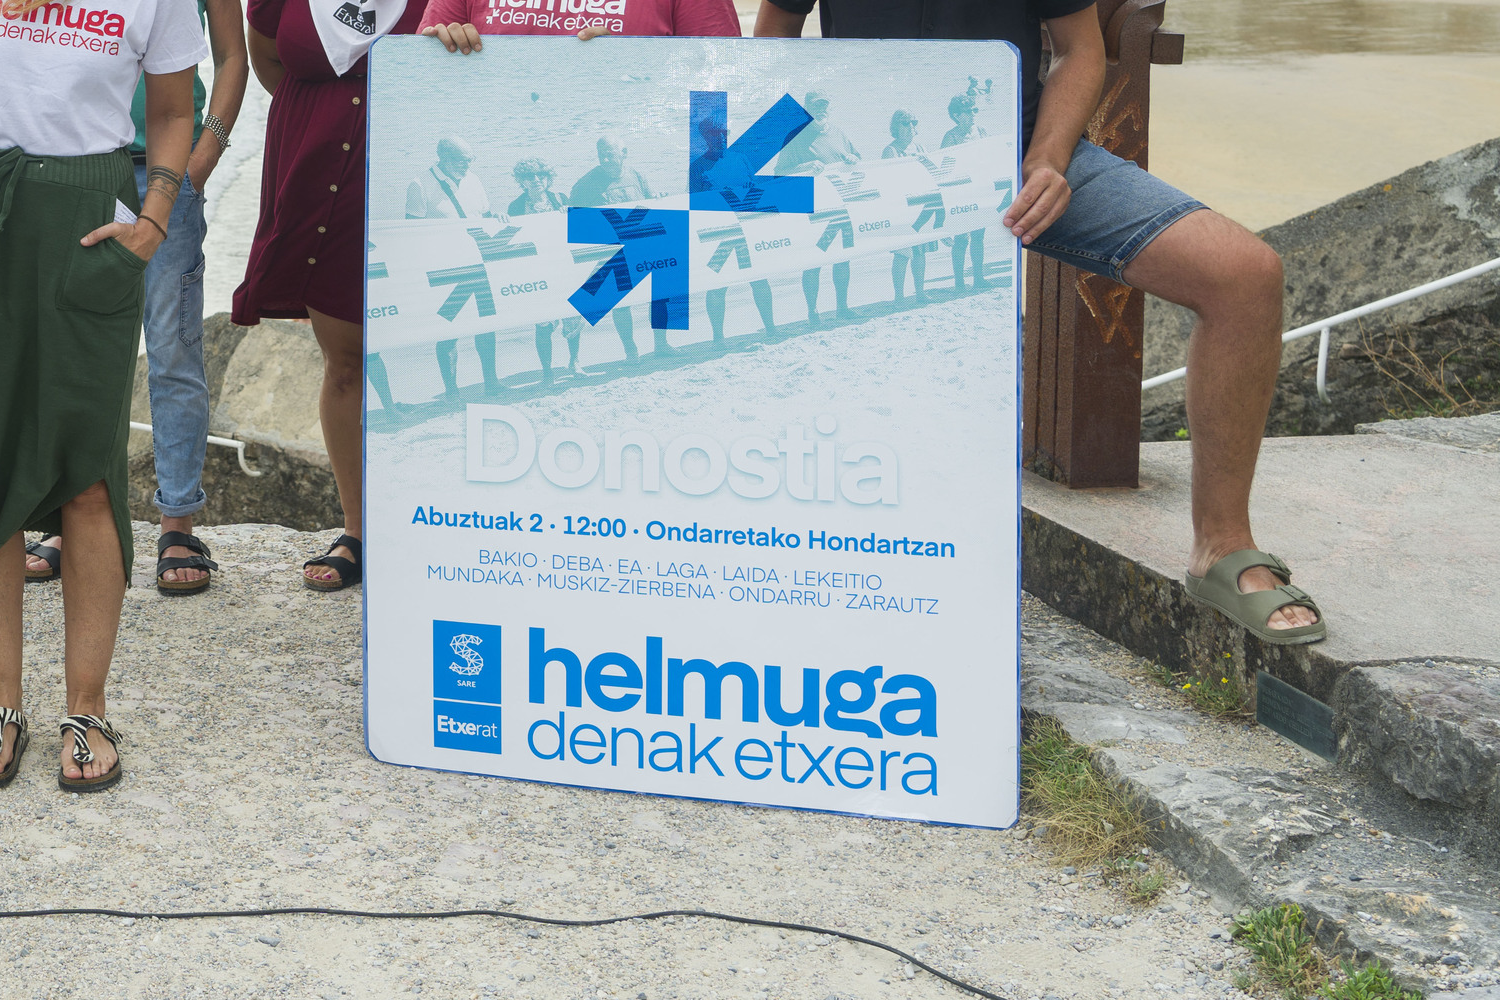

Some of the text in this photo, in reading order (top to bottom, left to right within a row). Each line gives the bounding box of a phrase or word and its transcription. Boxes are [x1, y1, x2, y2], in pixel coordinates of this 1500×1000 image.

[499, 8, 624, 32] denak etxera
[58, 31, 120, 56] etxera
[950, 202, 979, 215] etxera
[858, 217, 892, 233] etxera
[754, 236, 792, 252] etxera
[635, 255, 678, 273] etxera
[500, 278, 549, 297] etxera
[465, 402, 900, 506] Donostia
[411, 506, 956, 558] Abuztuak 2 12:00 Ondarretako Hondartzan
[479, 549, 883, 591] BAKIO DEBA EA LAGA LAIDA LEKEITIO
[427, 564, 939, 615] MUNDAKA MUSKIZ-ZIERBENA ONDARRU ZARAUTZ
[456, 679, 477, 688] SARE
[528, 626, 938, 739] helmuga
[437, 714, 498, 739] Etxerat
[527, 710, 939, 797] denak etxera
